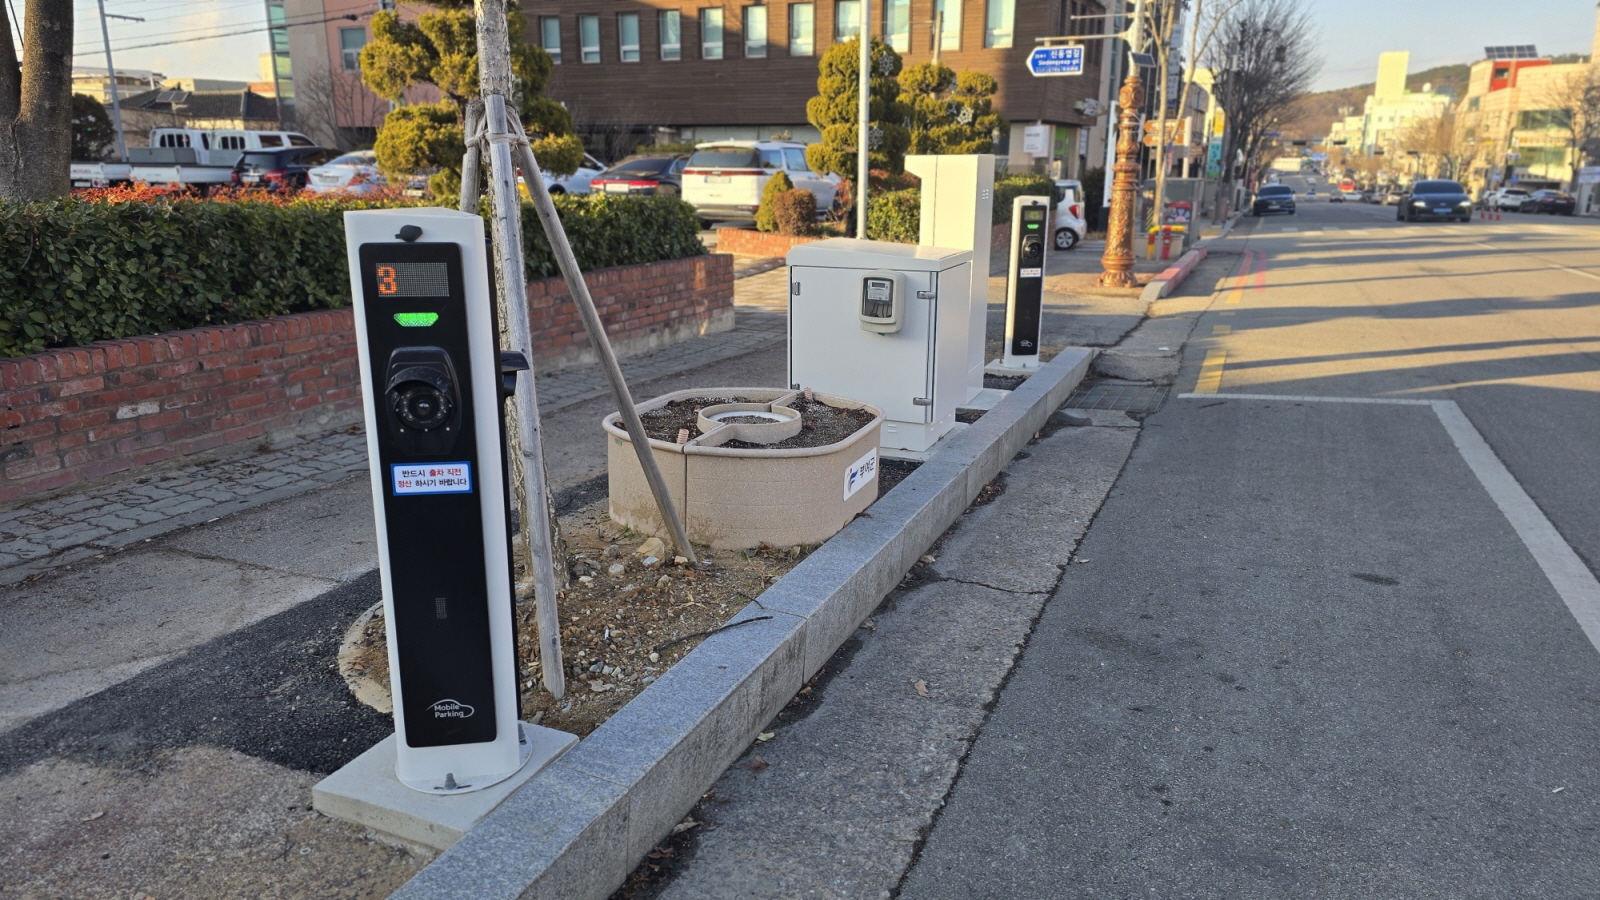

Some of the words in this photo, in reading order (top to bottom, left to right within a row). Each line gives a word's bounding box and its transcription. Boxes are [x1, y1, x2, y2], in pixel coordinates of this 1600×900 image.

[377, 266, 397, 294] 3
[859, 456, 875, 478] 부여군
[402, 469, 426, 478] 반드시
[429, 468, 444, 477] 출차
[447, 467, 462, 476] 직전
[398, 479, 412, 488] 정산
[415, 479, 437, 487] 하시기
[439, 478, 468, 486] 바랍니다
[434, 703, 460, 711] Mobile
[434, 710, 464, 718] Parking
